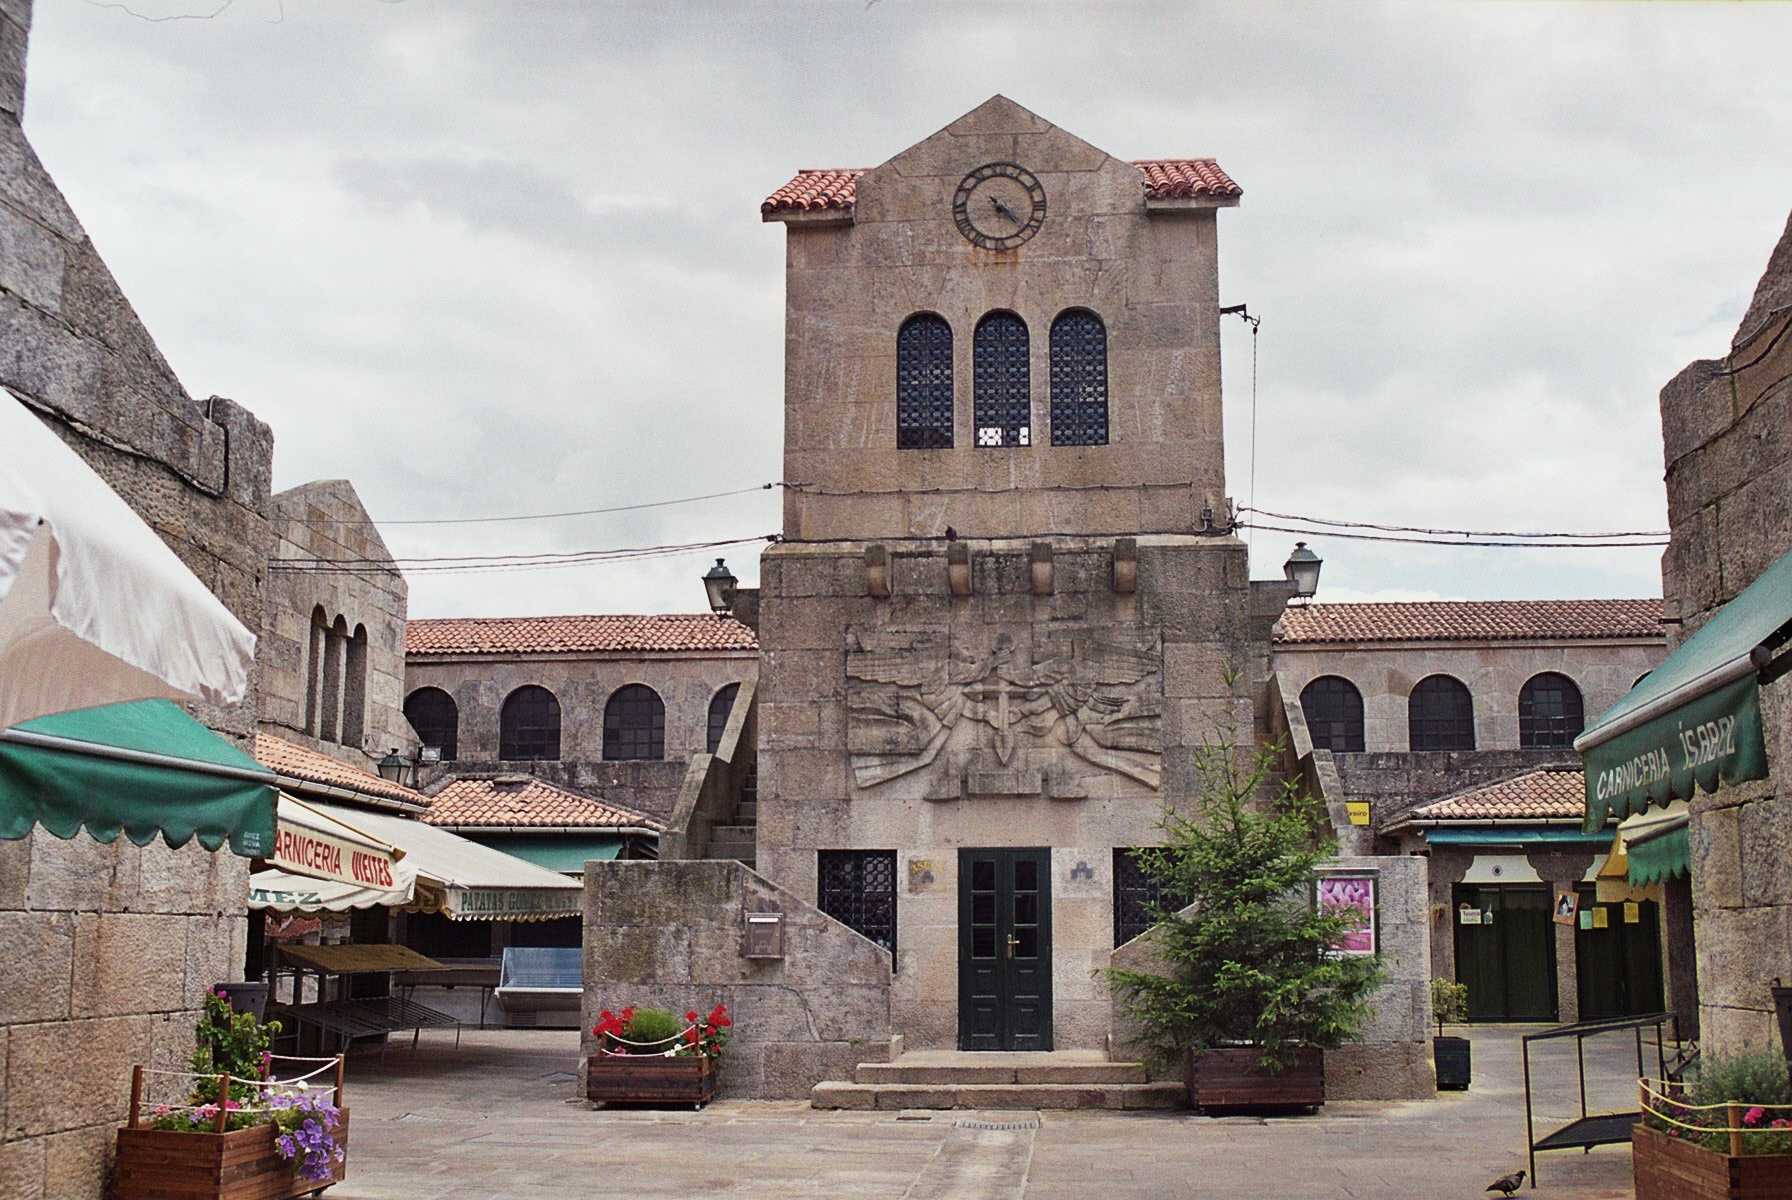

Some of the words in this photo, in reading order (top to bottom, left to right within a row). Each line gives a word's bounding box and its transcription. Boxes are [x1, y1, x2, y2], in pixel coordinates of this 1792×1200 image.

[1597, 747, 1671, 800] CARNICERIA
[275, 830, 342, 875] ARNICERIA
[248, 888, 321, 904] MEZ
[461, 892, 504, 911] PATATAS
